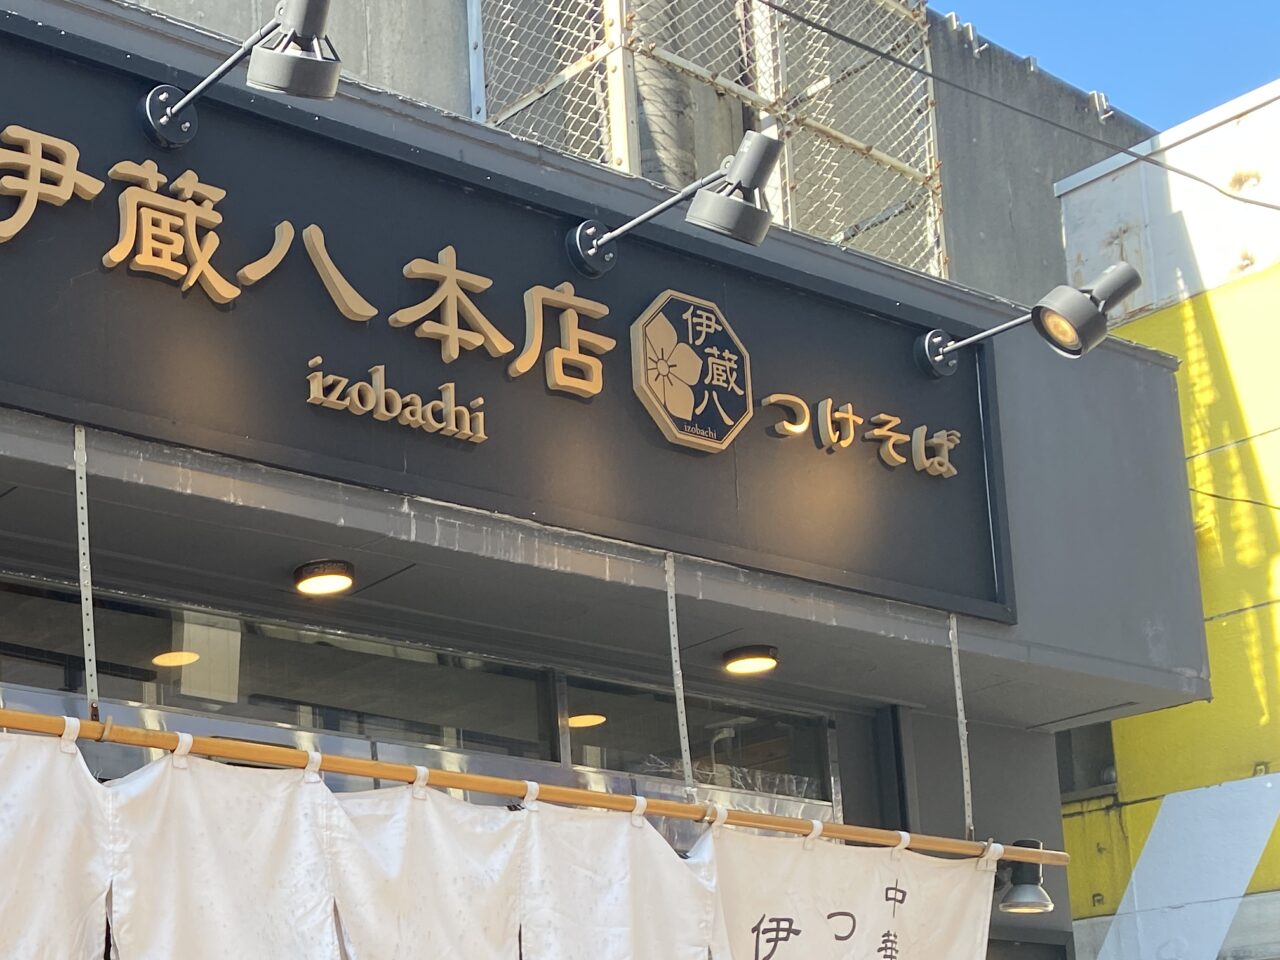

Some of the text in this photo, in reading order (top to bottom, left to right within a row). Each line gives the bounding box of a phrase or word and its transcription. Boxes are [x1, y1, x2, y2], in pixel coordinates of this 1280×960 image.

[306, 357, 488, 444] izobachi
[682, 304, 745, 426] 伊蔵八
[683, 421, 718, 440] izobachi
[762, 392, 961, 478] つけそば
